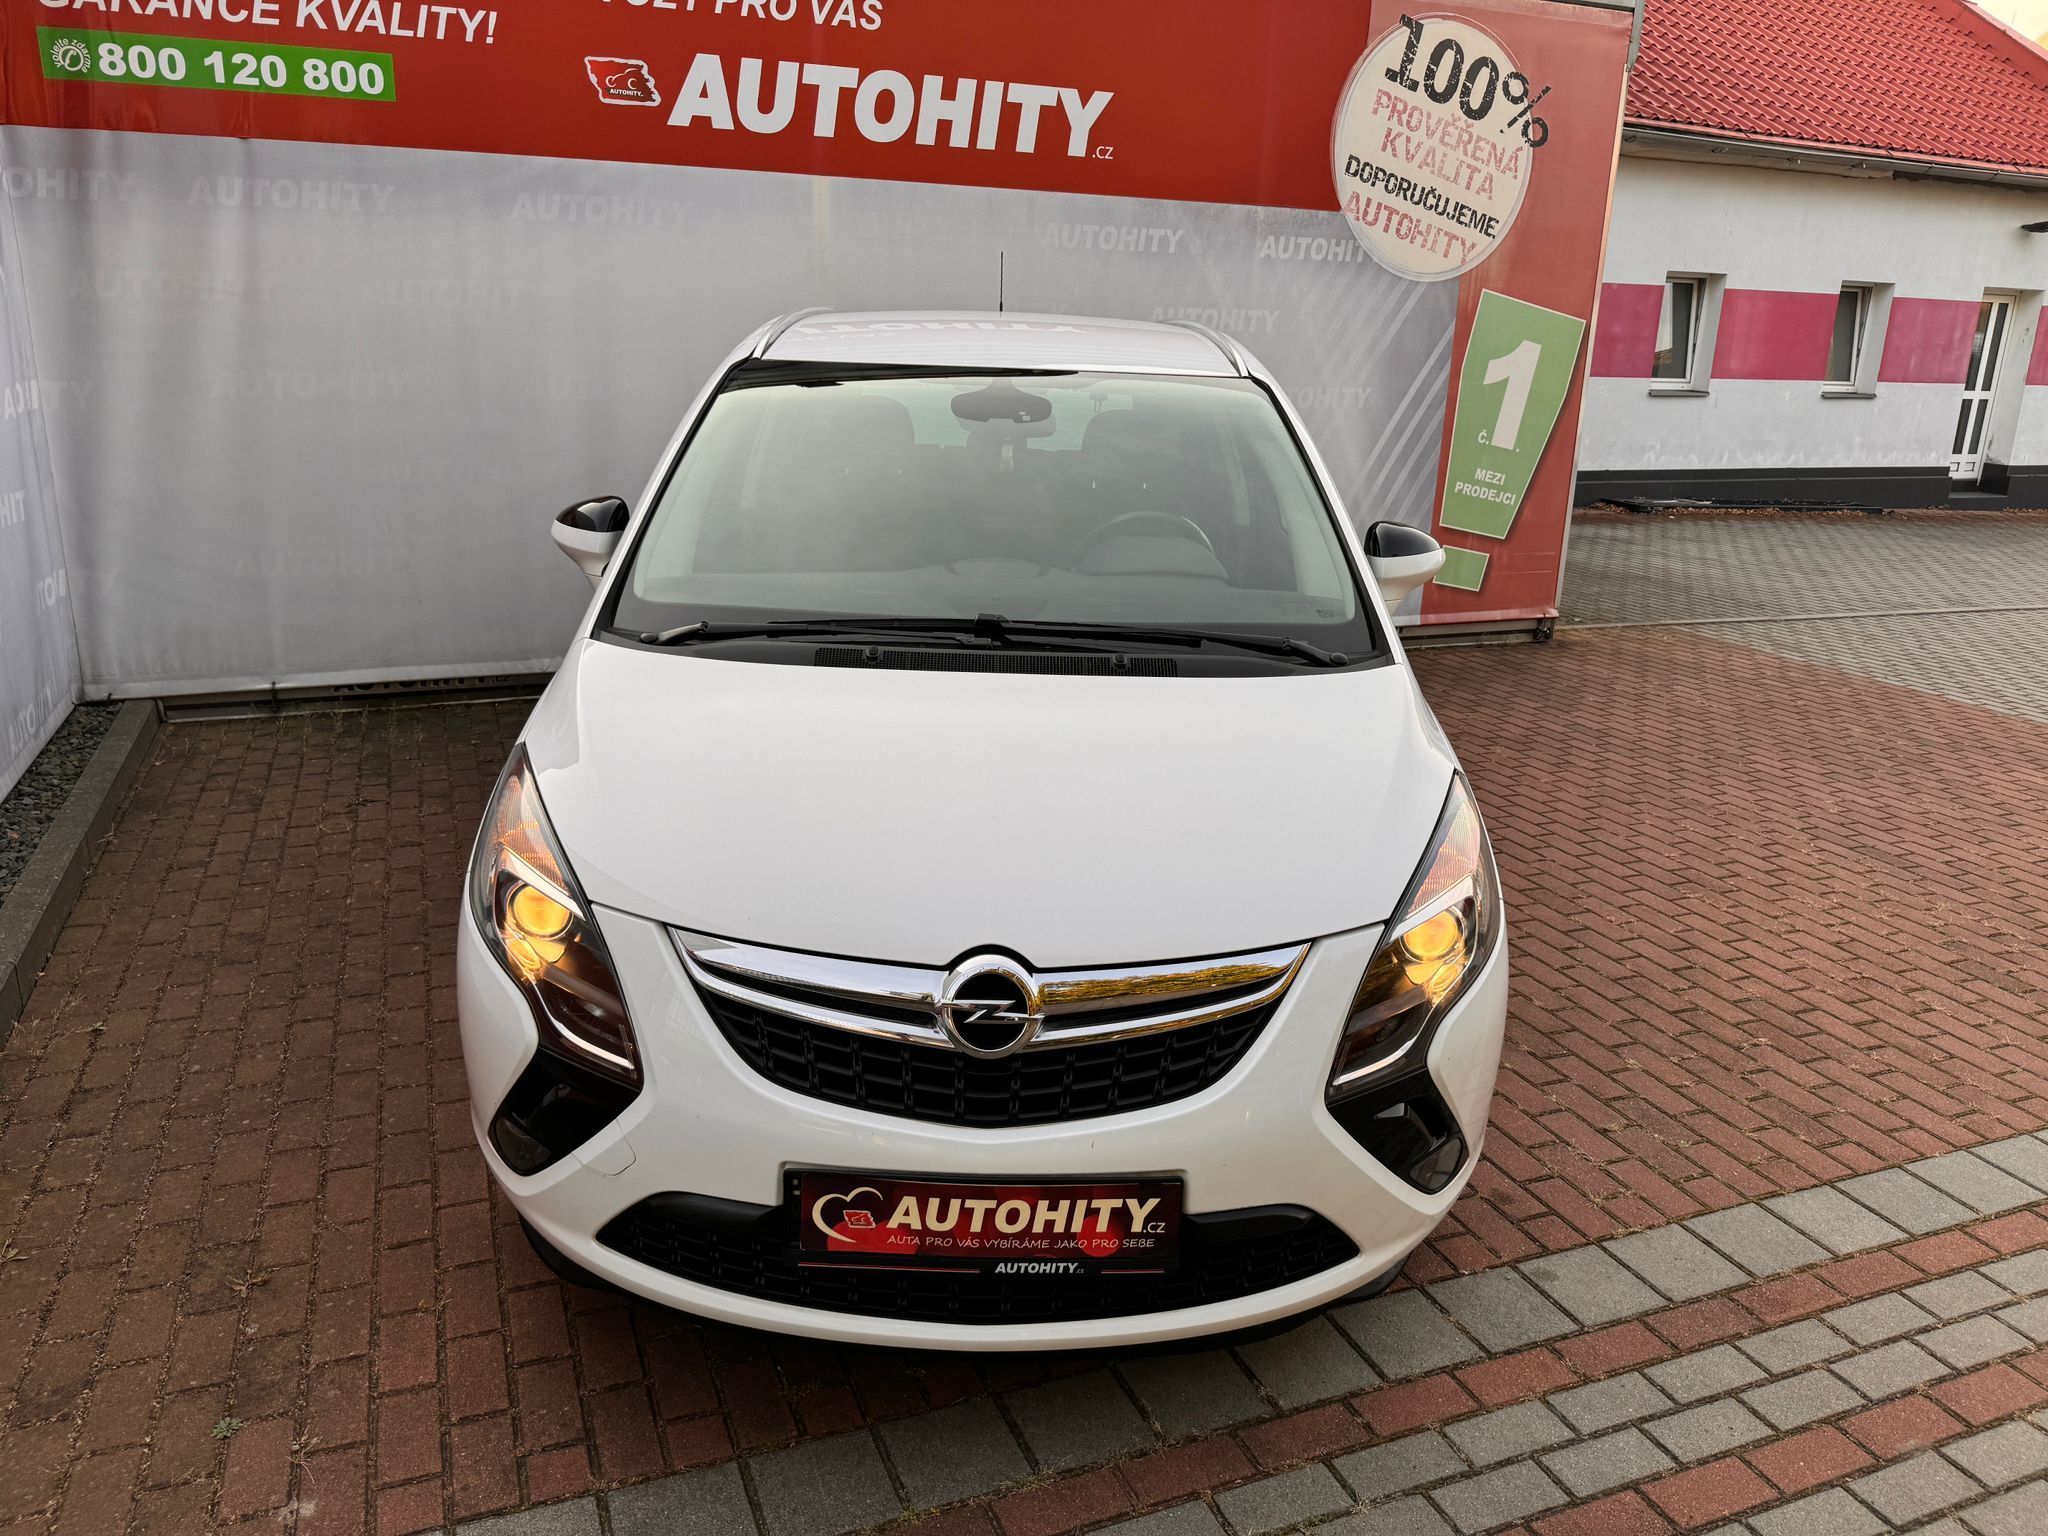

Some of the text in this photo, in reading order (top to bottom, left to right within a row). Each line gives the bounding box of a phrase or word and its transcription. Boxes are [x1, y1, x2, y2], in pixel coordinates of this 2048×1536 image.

[295, 0, 498, 45] KVALITY!
[97, 42, 385, 95] 800 120 800
[1385, 13, 1553, 148] 100%
[1371, 88, 1524, 180] PROVĚŘENÁ
[1379, 126, 1495, 200] KVALITA
[1344, 153, 1500, 239] DOPORUČUJEME
[1040, 220, 1185, 254] AUTOHITY
[1345, 190, 1477, 266] AUTOHITY
[1454, 481, 1517, 506] PRODEJCI
[1474, 467, 1507, 486] MEZI
[886, 1235, 1155, 1249] AUTA PRO VÁS VYBÍRÁME JAKO PRO SEBE
